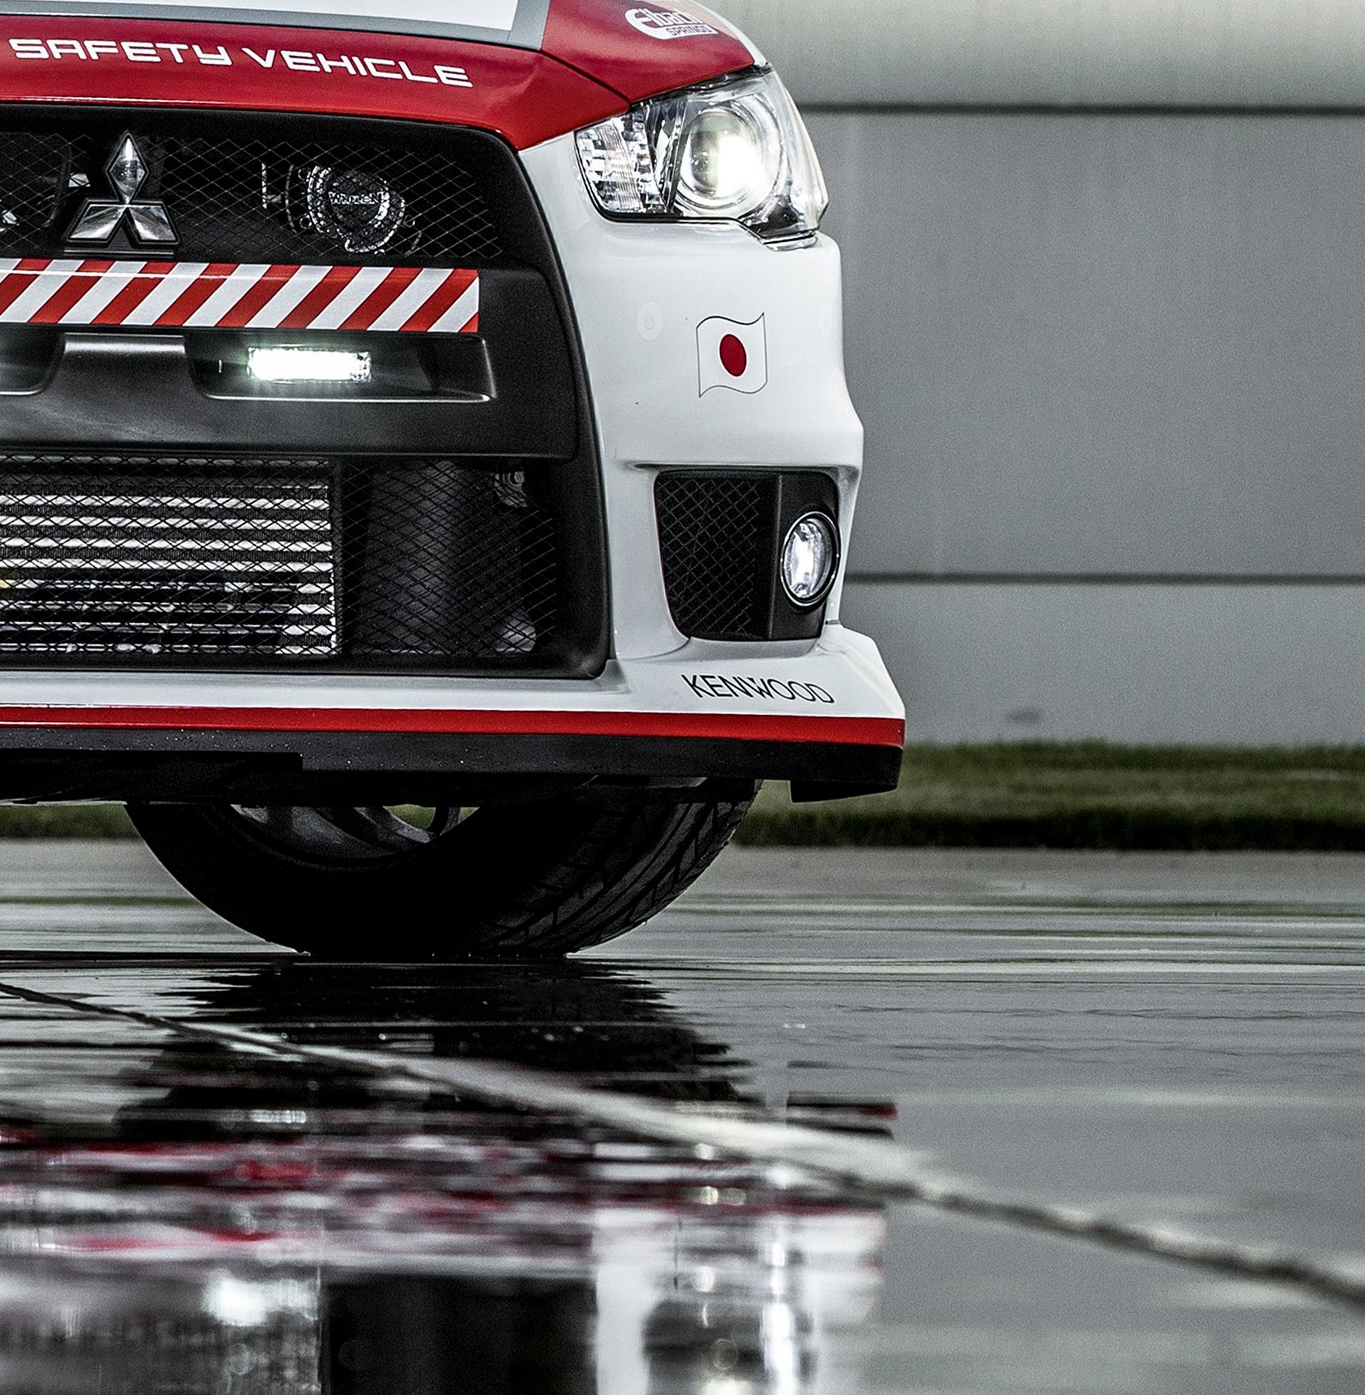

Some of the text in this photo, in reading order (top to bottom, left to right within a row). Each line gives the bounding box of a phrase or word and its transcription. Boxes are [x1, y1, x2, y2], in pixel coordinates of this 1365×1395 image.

[8, 38, 234, 66] SAFETY
[242, 47, 474, 89] VEHICLE
[681, 674, 835, 703] KENWOOD
